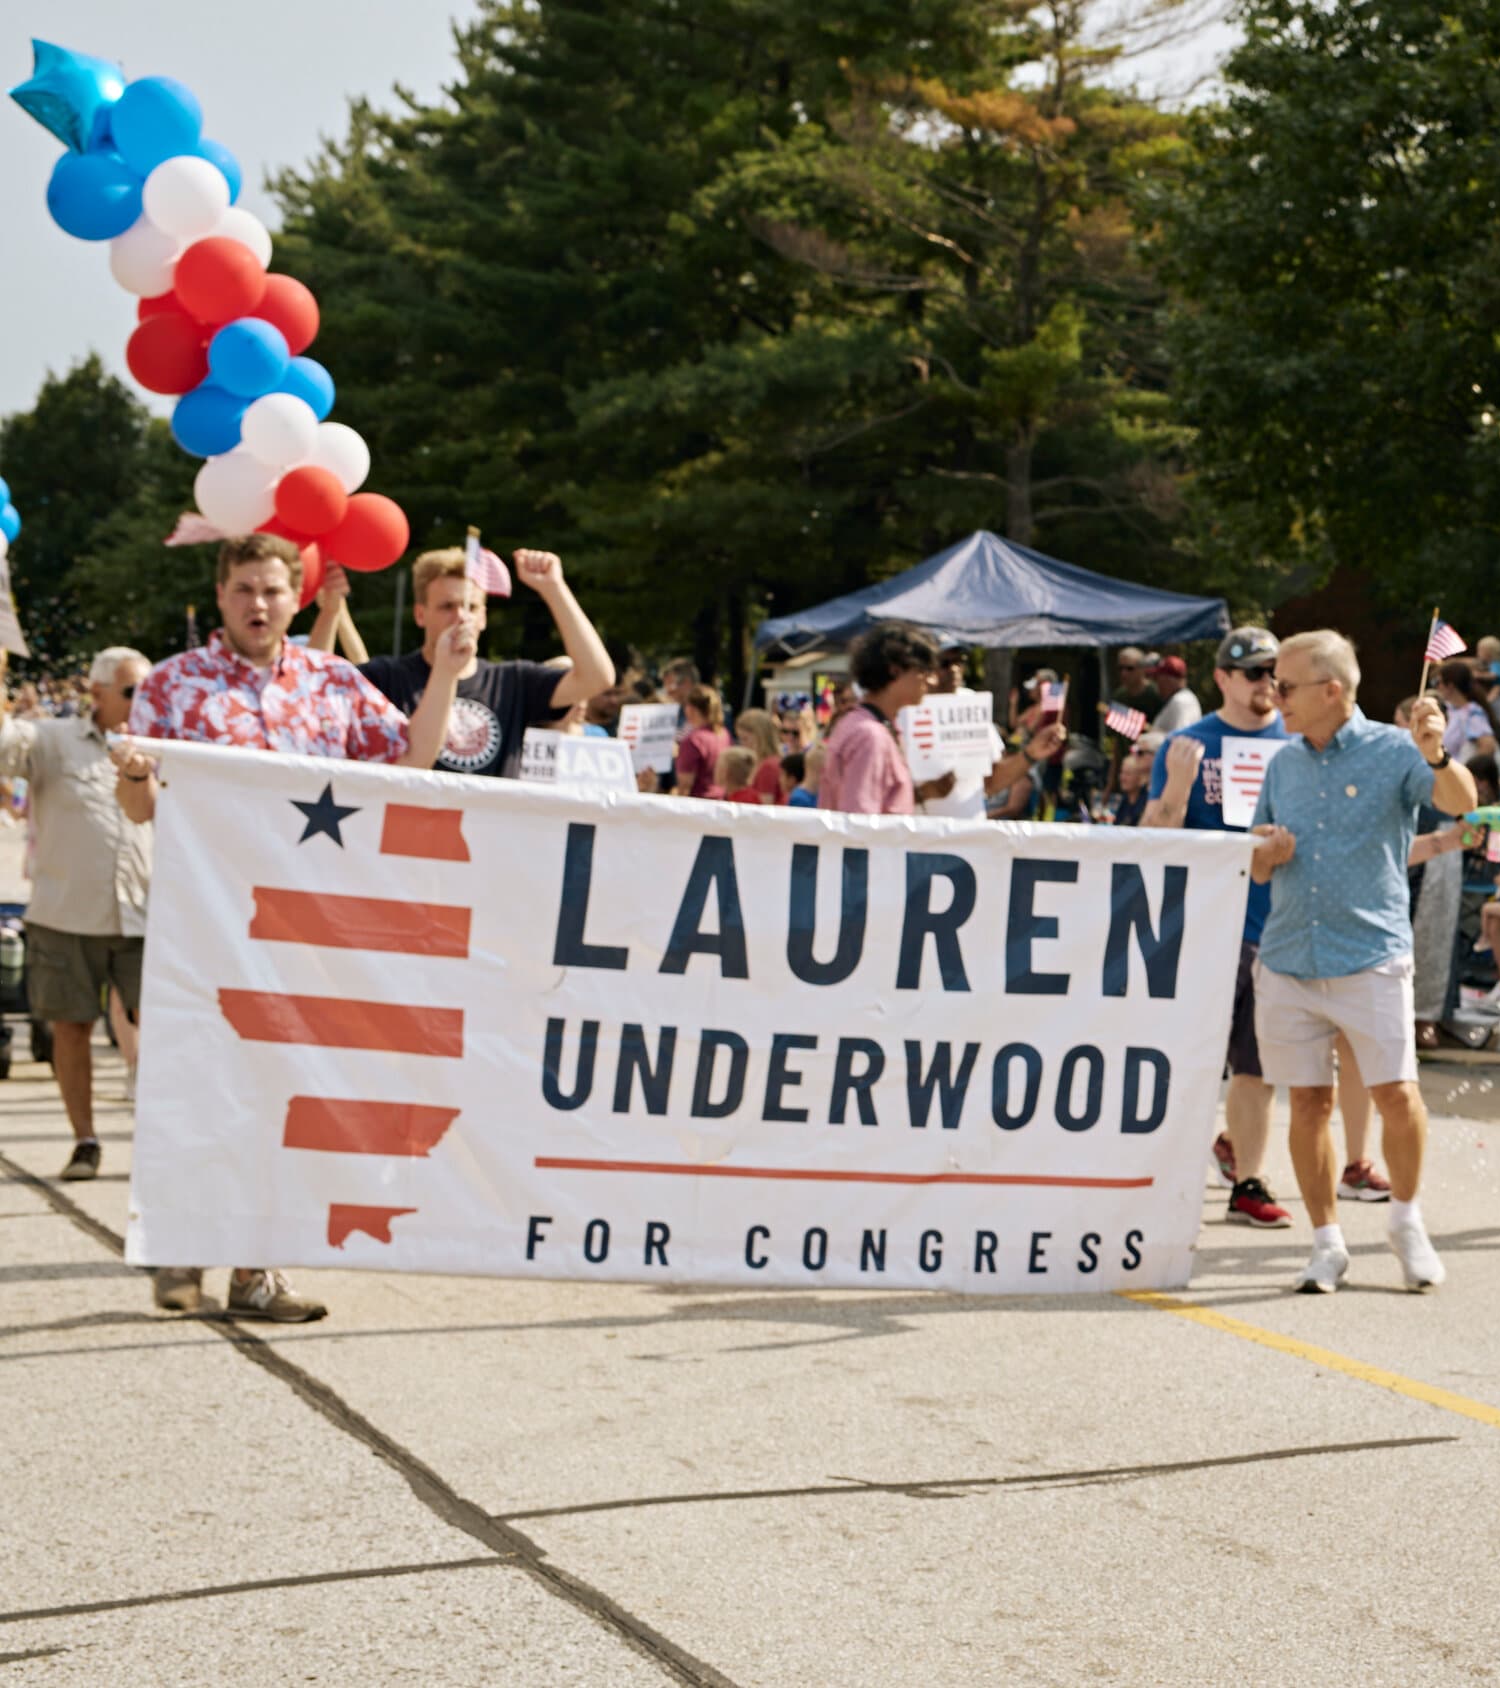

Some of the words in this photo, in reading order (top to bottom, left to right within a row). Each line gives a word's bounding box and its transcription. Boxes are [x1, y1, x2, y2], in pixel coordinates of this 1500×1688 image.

[939, 705, 988, 725] LAUREN
[552, 822, 1189, 999] LAUREN
[541, 1017, 1172, 1134] UNDERWOOD
[526, 1216, 671, 1266] FOR
[745, 1225, 1145, 1274] CONGRESS
